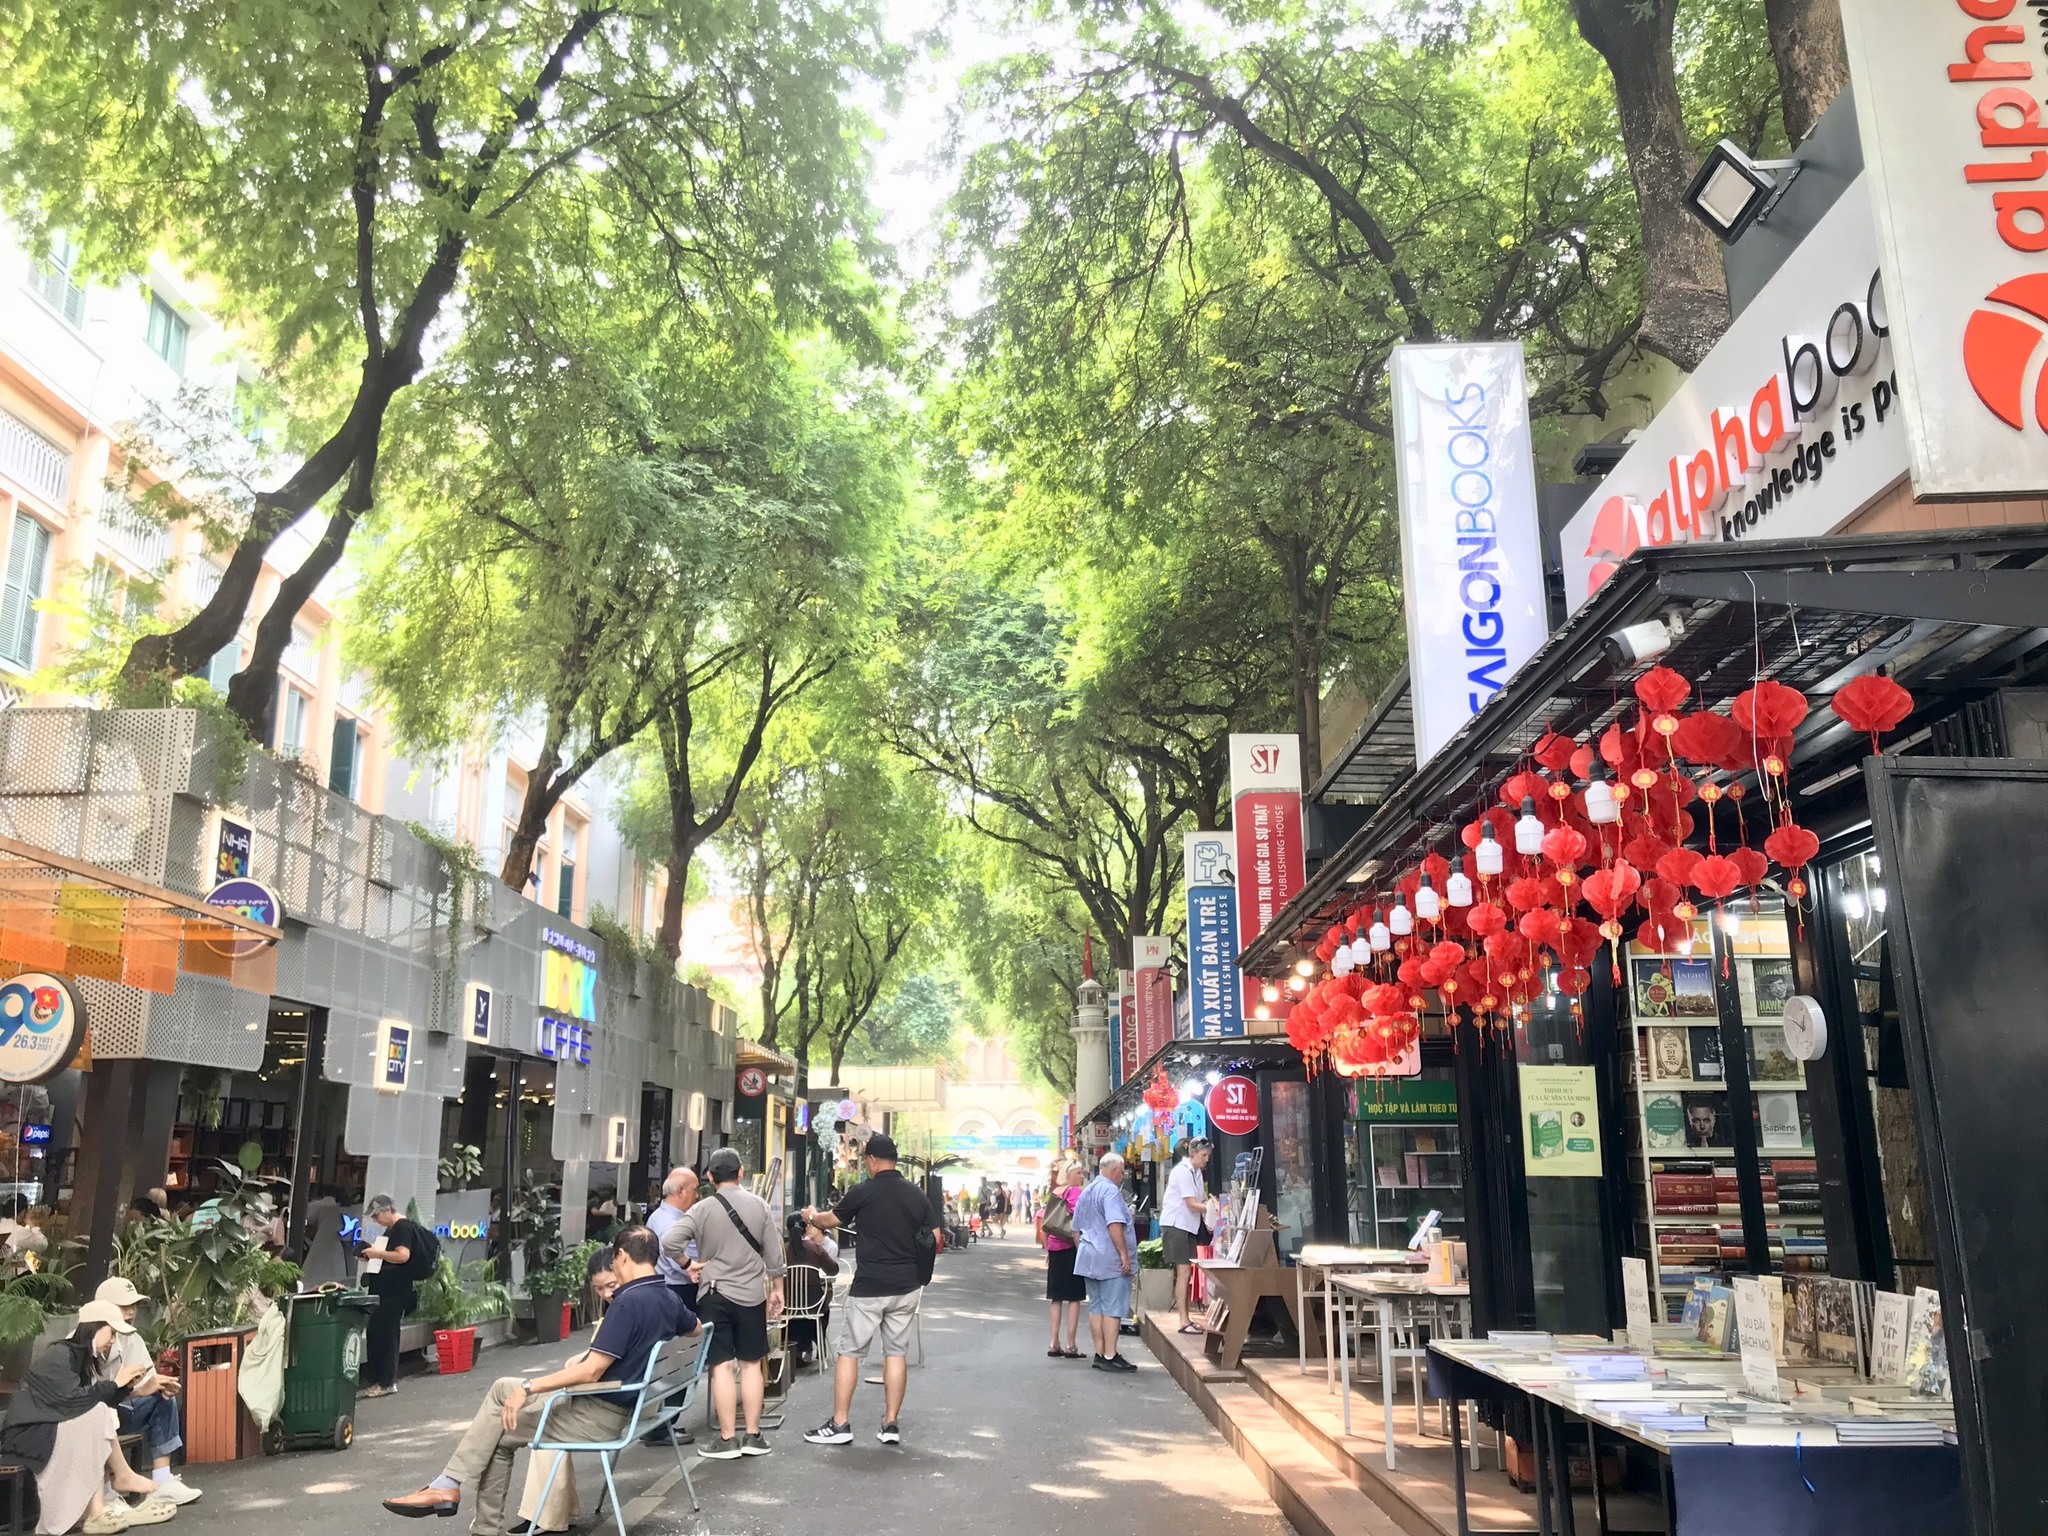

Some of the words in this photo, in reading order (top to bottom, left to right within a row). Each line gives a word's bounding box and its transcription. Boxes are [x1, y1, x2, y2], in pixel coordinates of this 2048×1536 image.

[1947, 0, 2048, 253] alph
[1719, 430, 1837, 542] knowledge
[1841, 402, 1866, 441] is
[1872, 368, 1898, 423] p
[1250, 744, 1280, 774] ST
[1252, 804, 1270, 827] THẬT
[1275, 804, 1285, 837] HOUSE
[222, 830, 249, 854] NHÀ
[1254, 827, 1271, 841] SỰ
[1256, 842, 1270, 858] GIA
[1253, 859, 1271, 885] QUỐC
[1276, 839, 1288, 897] PUBLISHING
[1258, 886, 1273, 902] TRỊ
[217, 905, 268, 924] OK
[1194, 896, 1217, 928] TRẺ
[1219, 894, 1229, 934] HOUSE
[1196, 930, 1218, 965] BẢN
[1690, 928, 1711, 944] ÁC
[540, 949, 598, 1023] BOOK
[1221, 941, 1233, 1018] PUBLISHING
[1677, 969, 1708, 980] Israel
[1197, 968, 1220, 1011] XUẤT
[1760, 1000, 1785, 1011] HAWK
[1200, 1013, 1221, 1037] HÀ
[13, 1034, 38, 1050] 26.3
[537, 1016, 592, 1065] CAFE
[1124, 1014, 1137, 1062] ĐÔNG
[388, 1059, 405, 1073] CITY
[1226, 1083, 1247, 1105] ST
[1384, 1101, 1398, 1115] TẬP
[1400, 1101, 1410, 1113] VÀ
[1411, 1101, 1427, 1113] LÀM
[1428, 1103, 1447, 1113] THEO
[32, 1128, 50, 1139] pepsi
[1763, 1123, 1797, 1132] Sapiens
[434, 1220, 487, 1239] mbook
